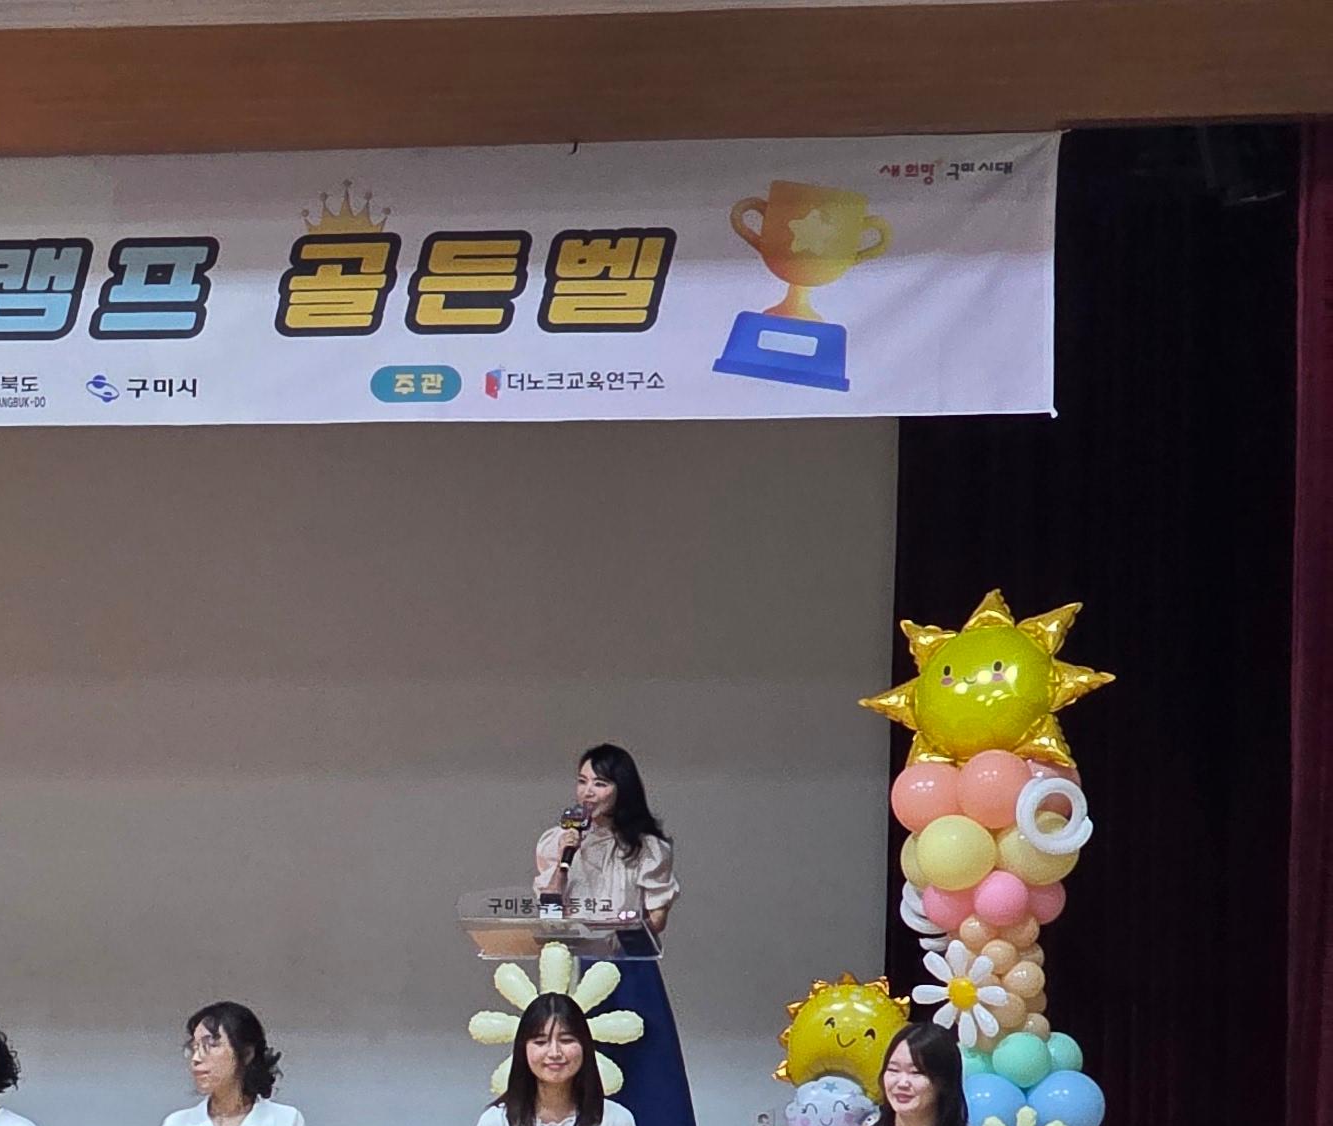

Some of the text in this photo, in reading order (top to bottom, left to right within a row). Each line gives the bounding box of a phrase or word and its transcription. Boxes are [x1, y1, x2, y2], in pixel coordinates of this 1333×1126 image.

[274, 227, 677, 338] 골든벨
[126, 377, 199, 399] 구미시
[393, 370, 666, 395] 주관 더노크교육연구소
